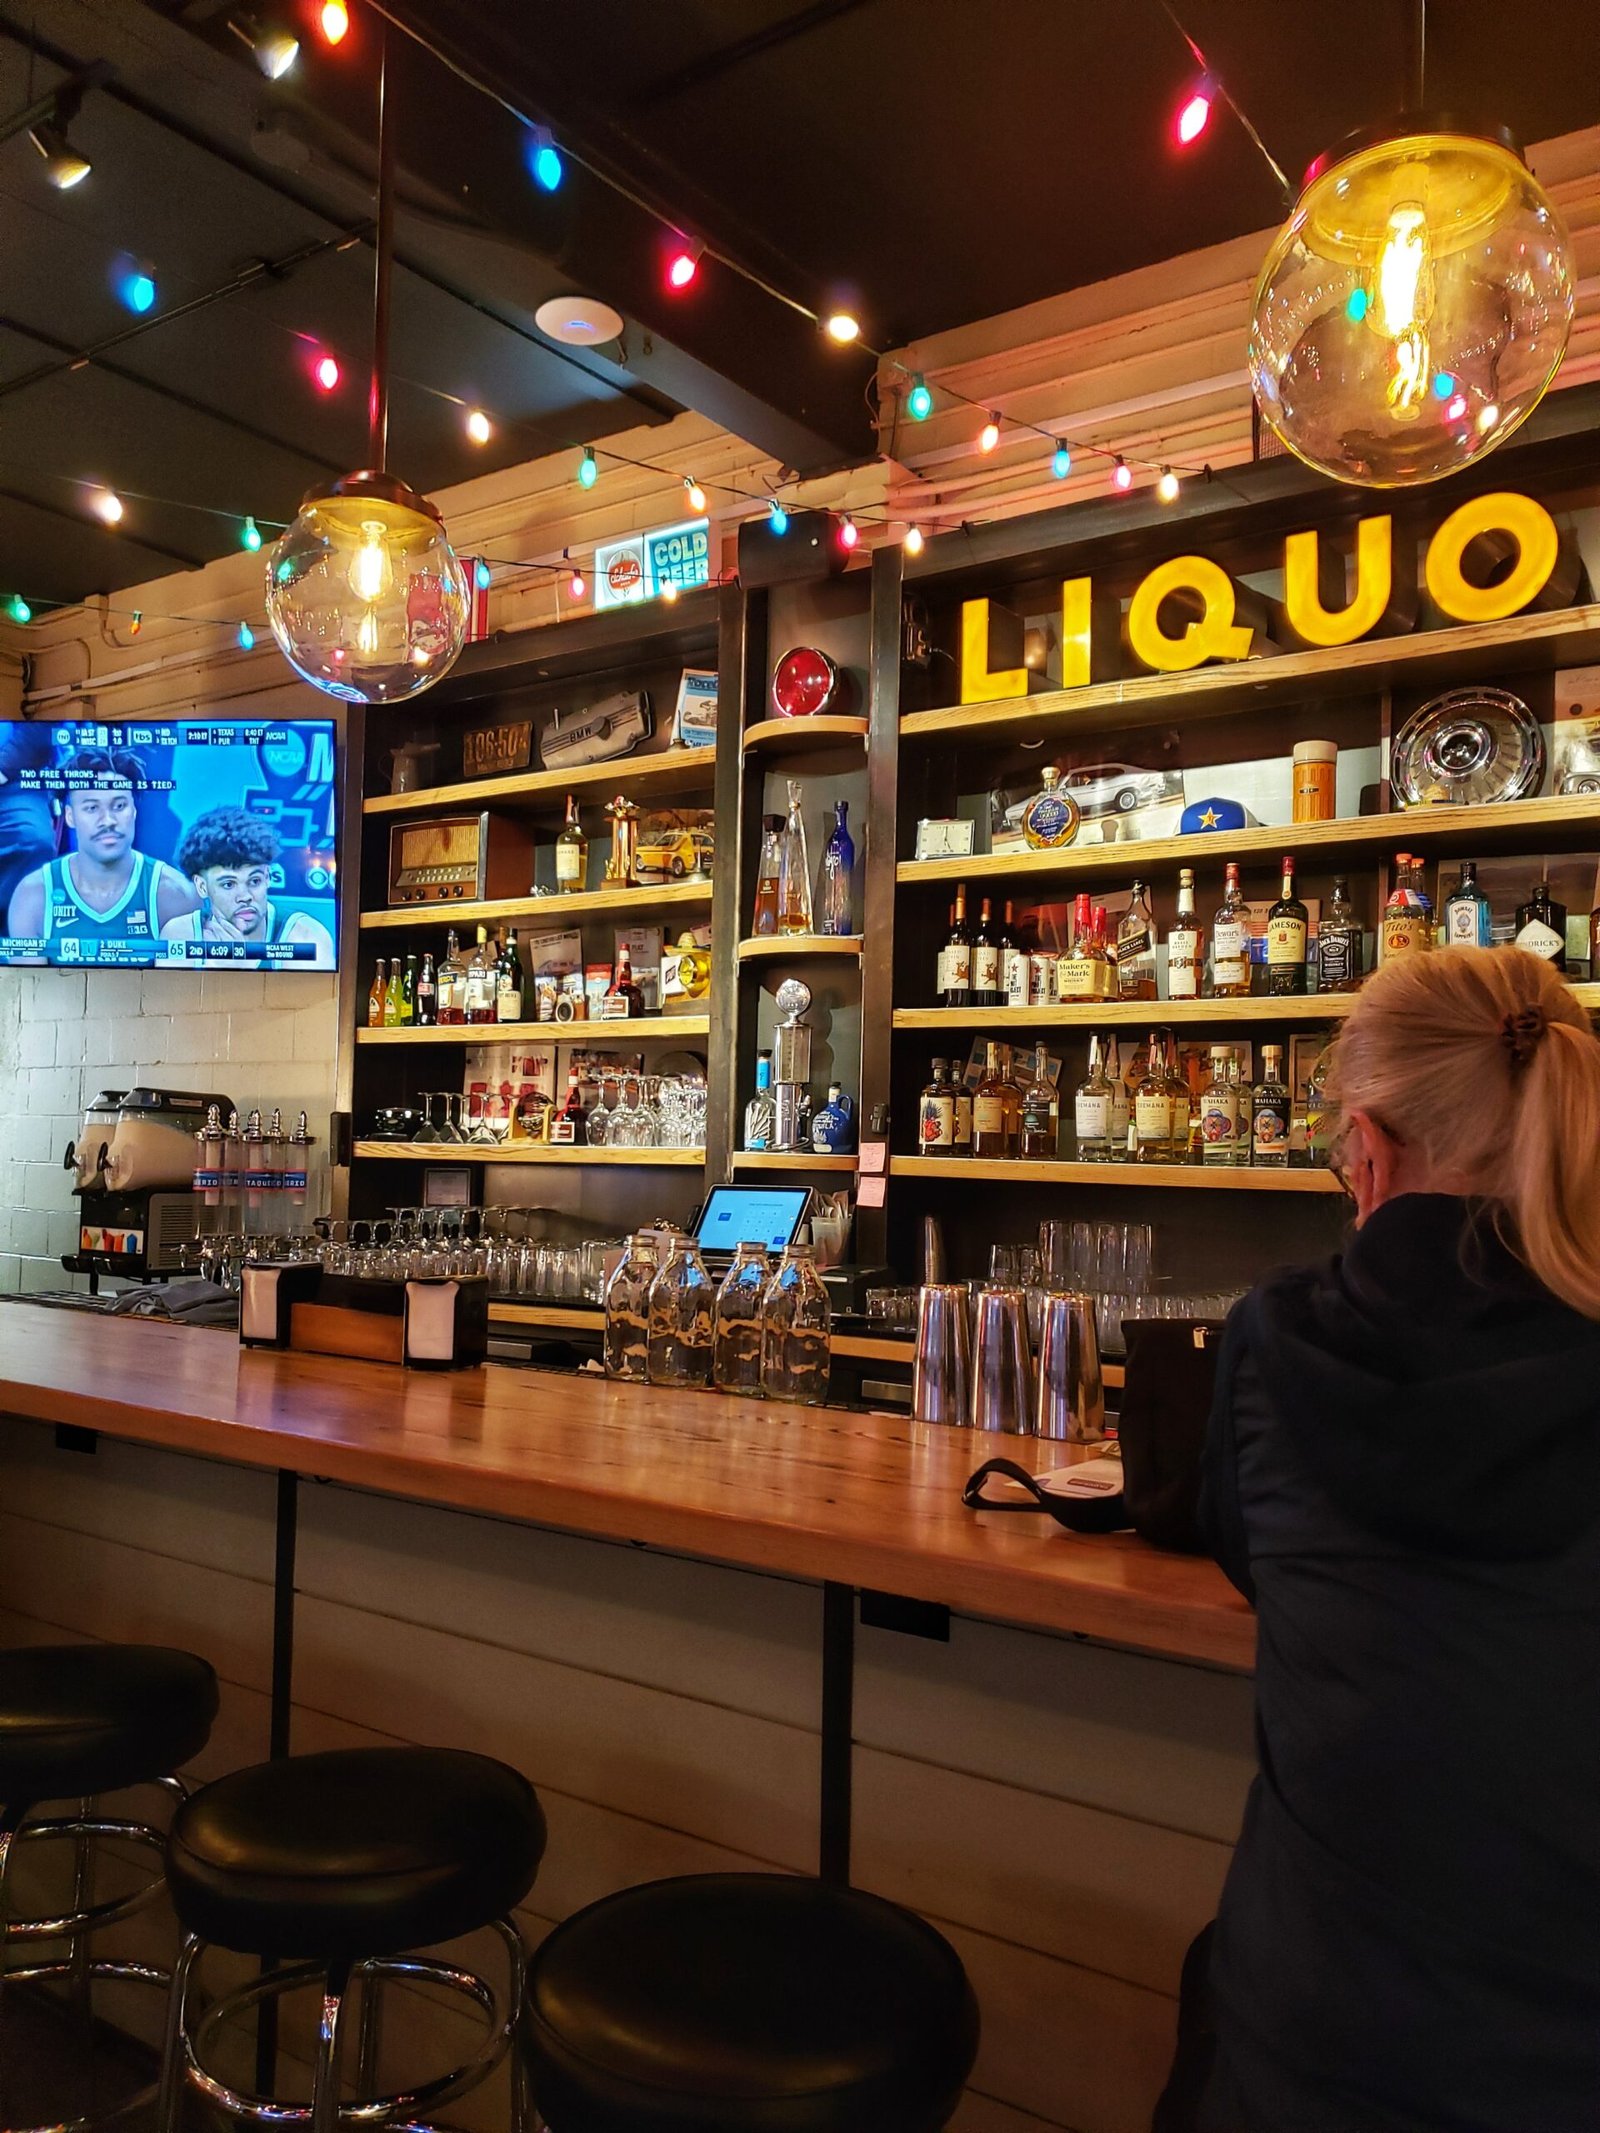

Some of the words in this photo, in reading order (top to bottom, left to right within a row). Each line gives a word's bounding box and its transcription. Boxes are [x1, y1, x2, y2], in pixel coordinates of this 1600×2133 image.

[653, 531, 708, 567] COLD
[961, 491, 1560, 705] LIQUO
[134, 732, 151, 742] tbs
[218, 728, 235, 736] TEXAS
[569, 726, 593, 743] BMW
[21, 769, 36, 779] TWO
[40, 769, 60, 779] FREE
[64, 769, 98, 779] THROWS.
[20, 780, 41, 789] MAKE
[69, 780, 90, 789] BOTH
[93, 780, 108, 789] THE
[112, 780, 133, 789] GAME
[137, 780, 148, 789] IS
[152, 780, 176, 789] TIED.
[53, 905, 77, 917] UNITY
[1386, 921, 1413, 932] Tito's
[2, 939, 38, 948] MICHIGAN
[39, 939, 47, 948] ST
[63, 943, 77, 954] 64
[107, 941, 127, 949] DUKE
[1528, 939, 1560, 947] DRICK'S
[170, 943, 184, 956] 65
[189, 946, 203, 956] 2ND
[210, 945, 229, 957] 6:09
[234, 946, 244, 957] 30
